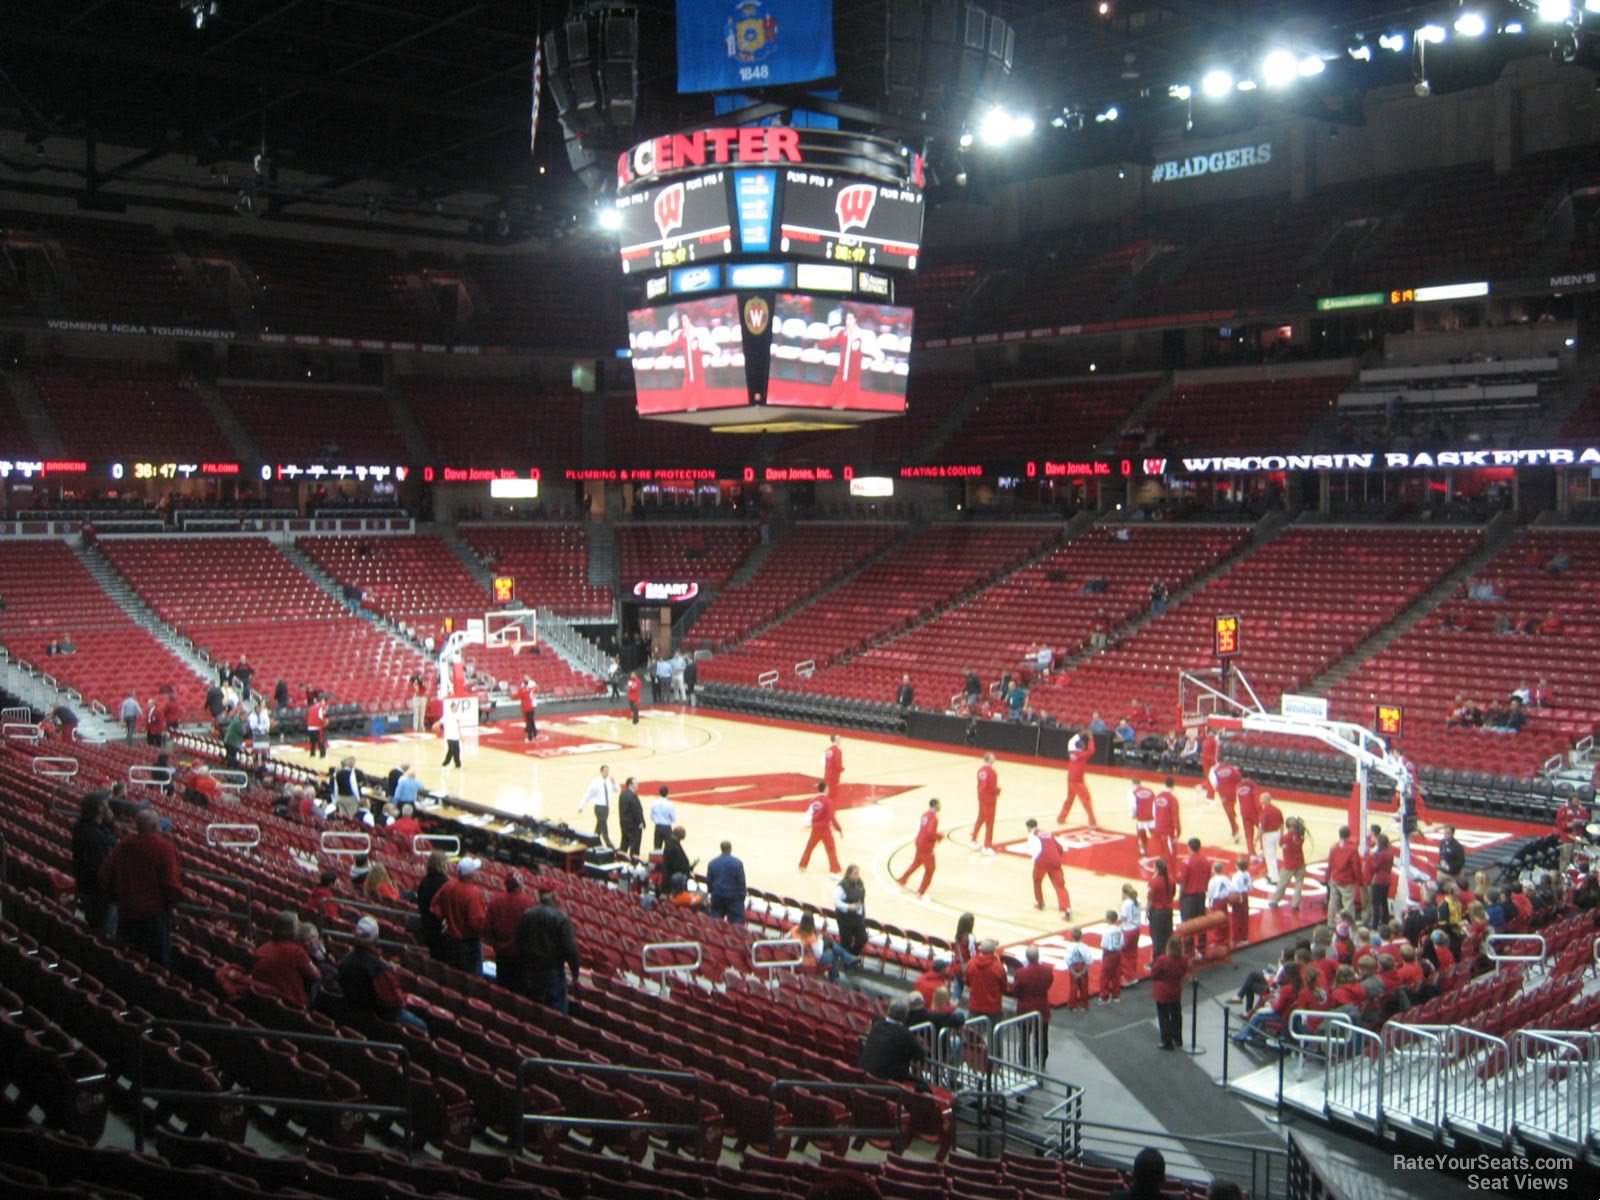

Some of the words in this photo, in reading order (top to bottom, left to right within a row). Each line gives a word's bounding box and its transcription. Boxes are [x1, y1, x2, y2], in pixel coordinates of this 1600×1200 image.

[739, 65, 769, 81] 1848
[634, 127, 802, 177] CENTER
[1151, 143, 1272, 183] #BADGERS
[835, 246, 866, 262] :47
[1550, 273, 1597, 287] MEN'S
[1391, 289, 1413, 304] 6:19
[48, 320, 108, 332] WOMEN'S
[112, 323, 146, 334] NCAA
[151, 326, 237, 339] TOURNAMENT
[47, 462, 86, 472] BADGERS
[203, 463, 239, 473] FALCONS
[1045, 462, 1065, 474] Dave
[1067, 462, 1093, 475] Jones,
[1095, 461, 1110, 474] Inc.
[1183, 454, 1374, 471] WISCONSIN
[112, 464, 123, 479] 0
[134, 463, 177, 479] 36:47
[262, 465, 271, 480] 0
[444, 468, 467, 480] Dave
[469, 468, 497, 481] Jones,
[500, 468, 518, 479] Inc.
[566, 469, 616, 479] PLUMBING
[620, 469, 628, 479] &
[632, 470, 651, 479] FIRE
[655, 470, 715, 479] PROTECTION
[766, 468, 787, 479] Dave
[789, 468, 814, 480] Jones,
[816, 468, 832, 479] Inc.
[901, 467, 937, 477] HEATING
[939, 467, 945, 476] &
[948, 466, 982, 476] COOLING
[1219, 631, 1233, 651] 35
[1382, 719, 1396, 731] 35
